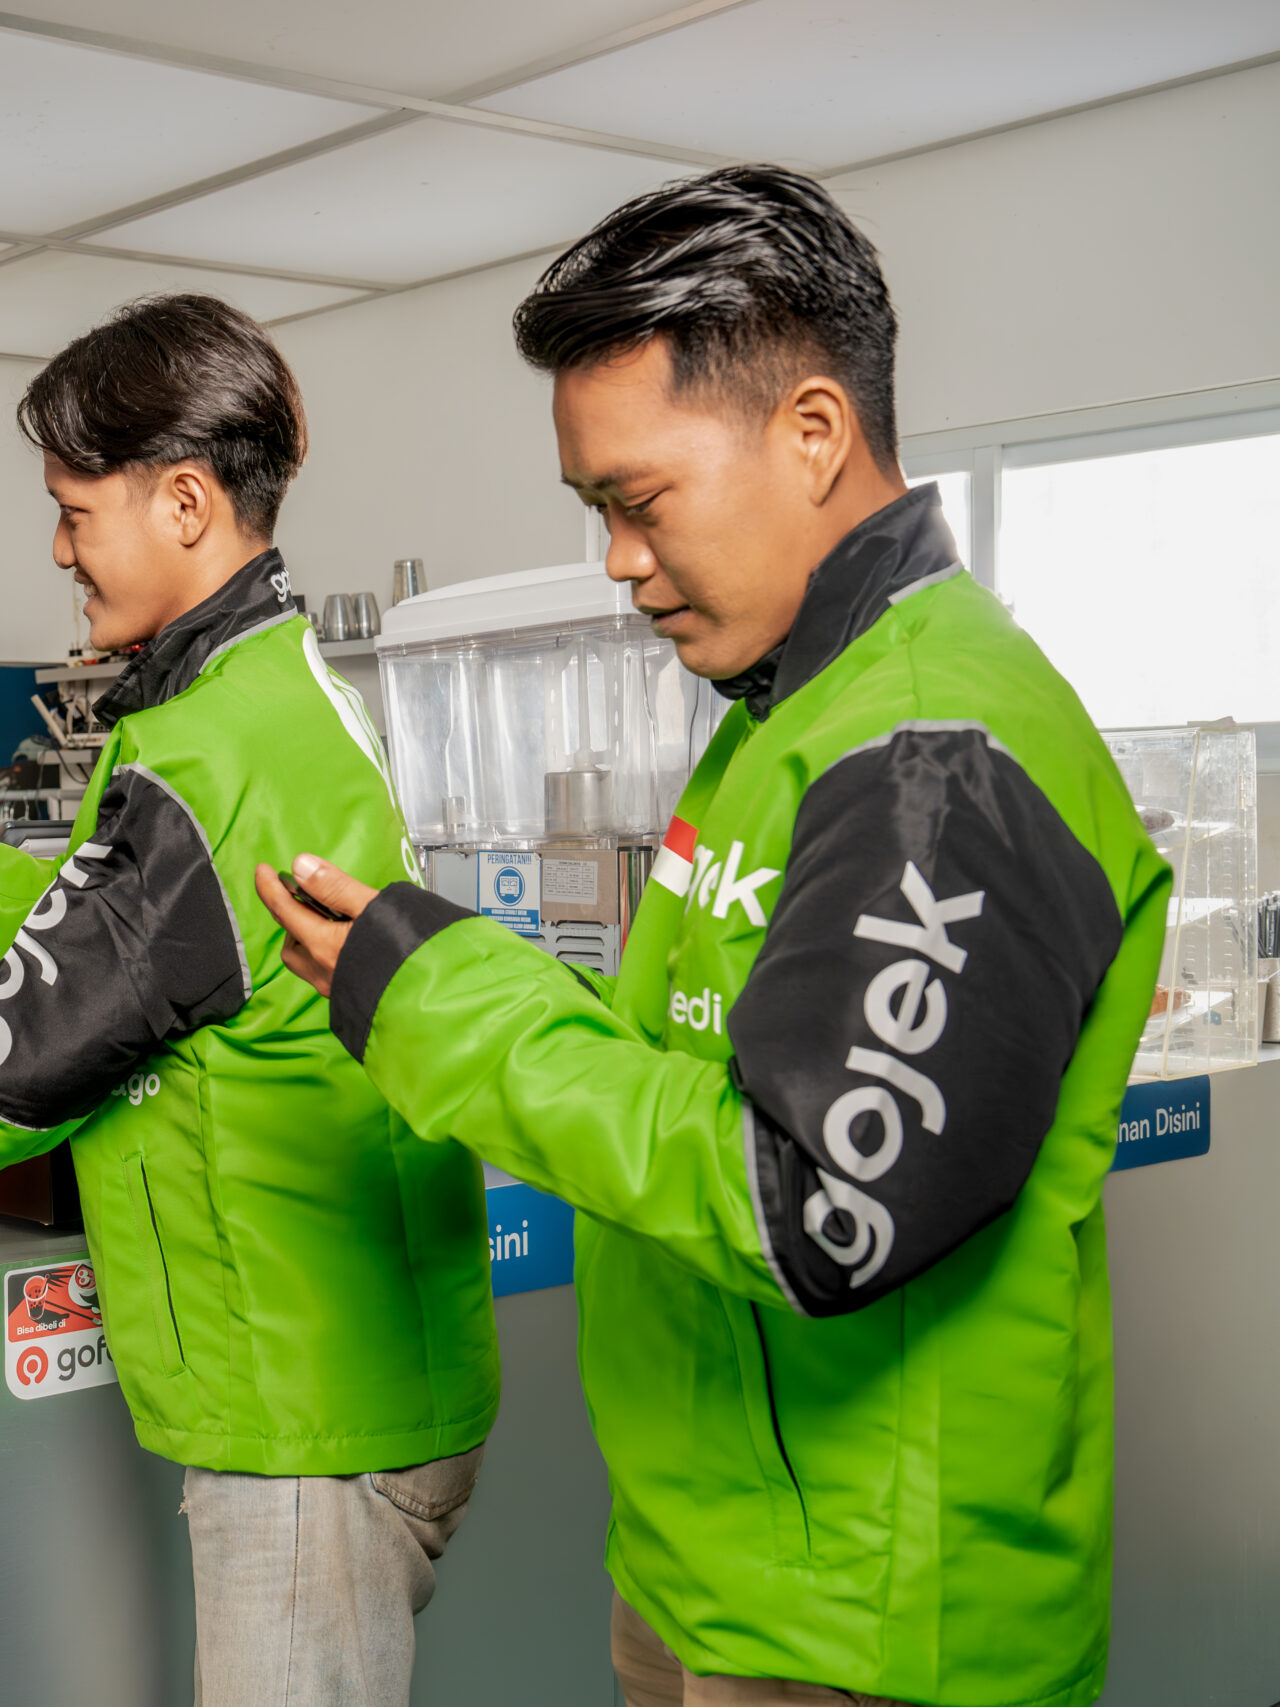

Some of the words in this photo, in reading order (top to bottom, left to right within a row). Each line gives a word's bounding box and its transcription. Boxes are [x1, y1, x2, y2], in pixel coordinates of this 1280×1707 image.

[487, 854, 531, 864] PERINGATAN!!!
[803, 860, 985, 1290] gojek
[1156, 1101, 1200, 1136] Disini
[16, 1326, 35, 1336] Bisa
[35, 1319, 58, 1332] dibeli
[58, 1318, 66, 1328] di
